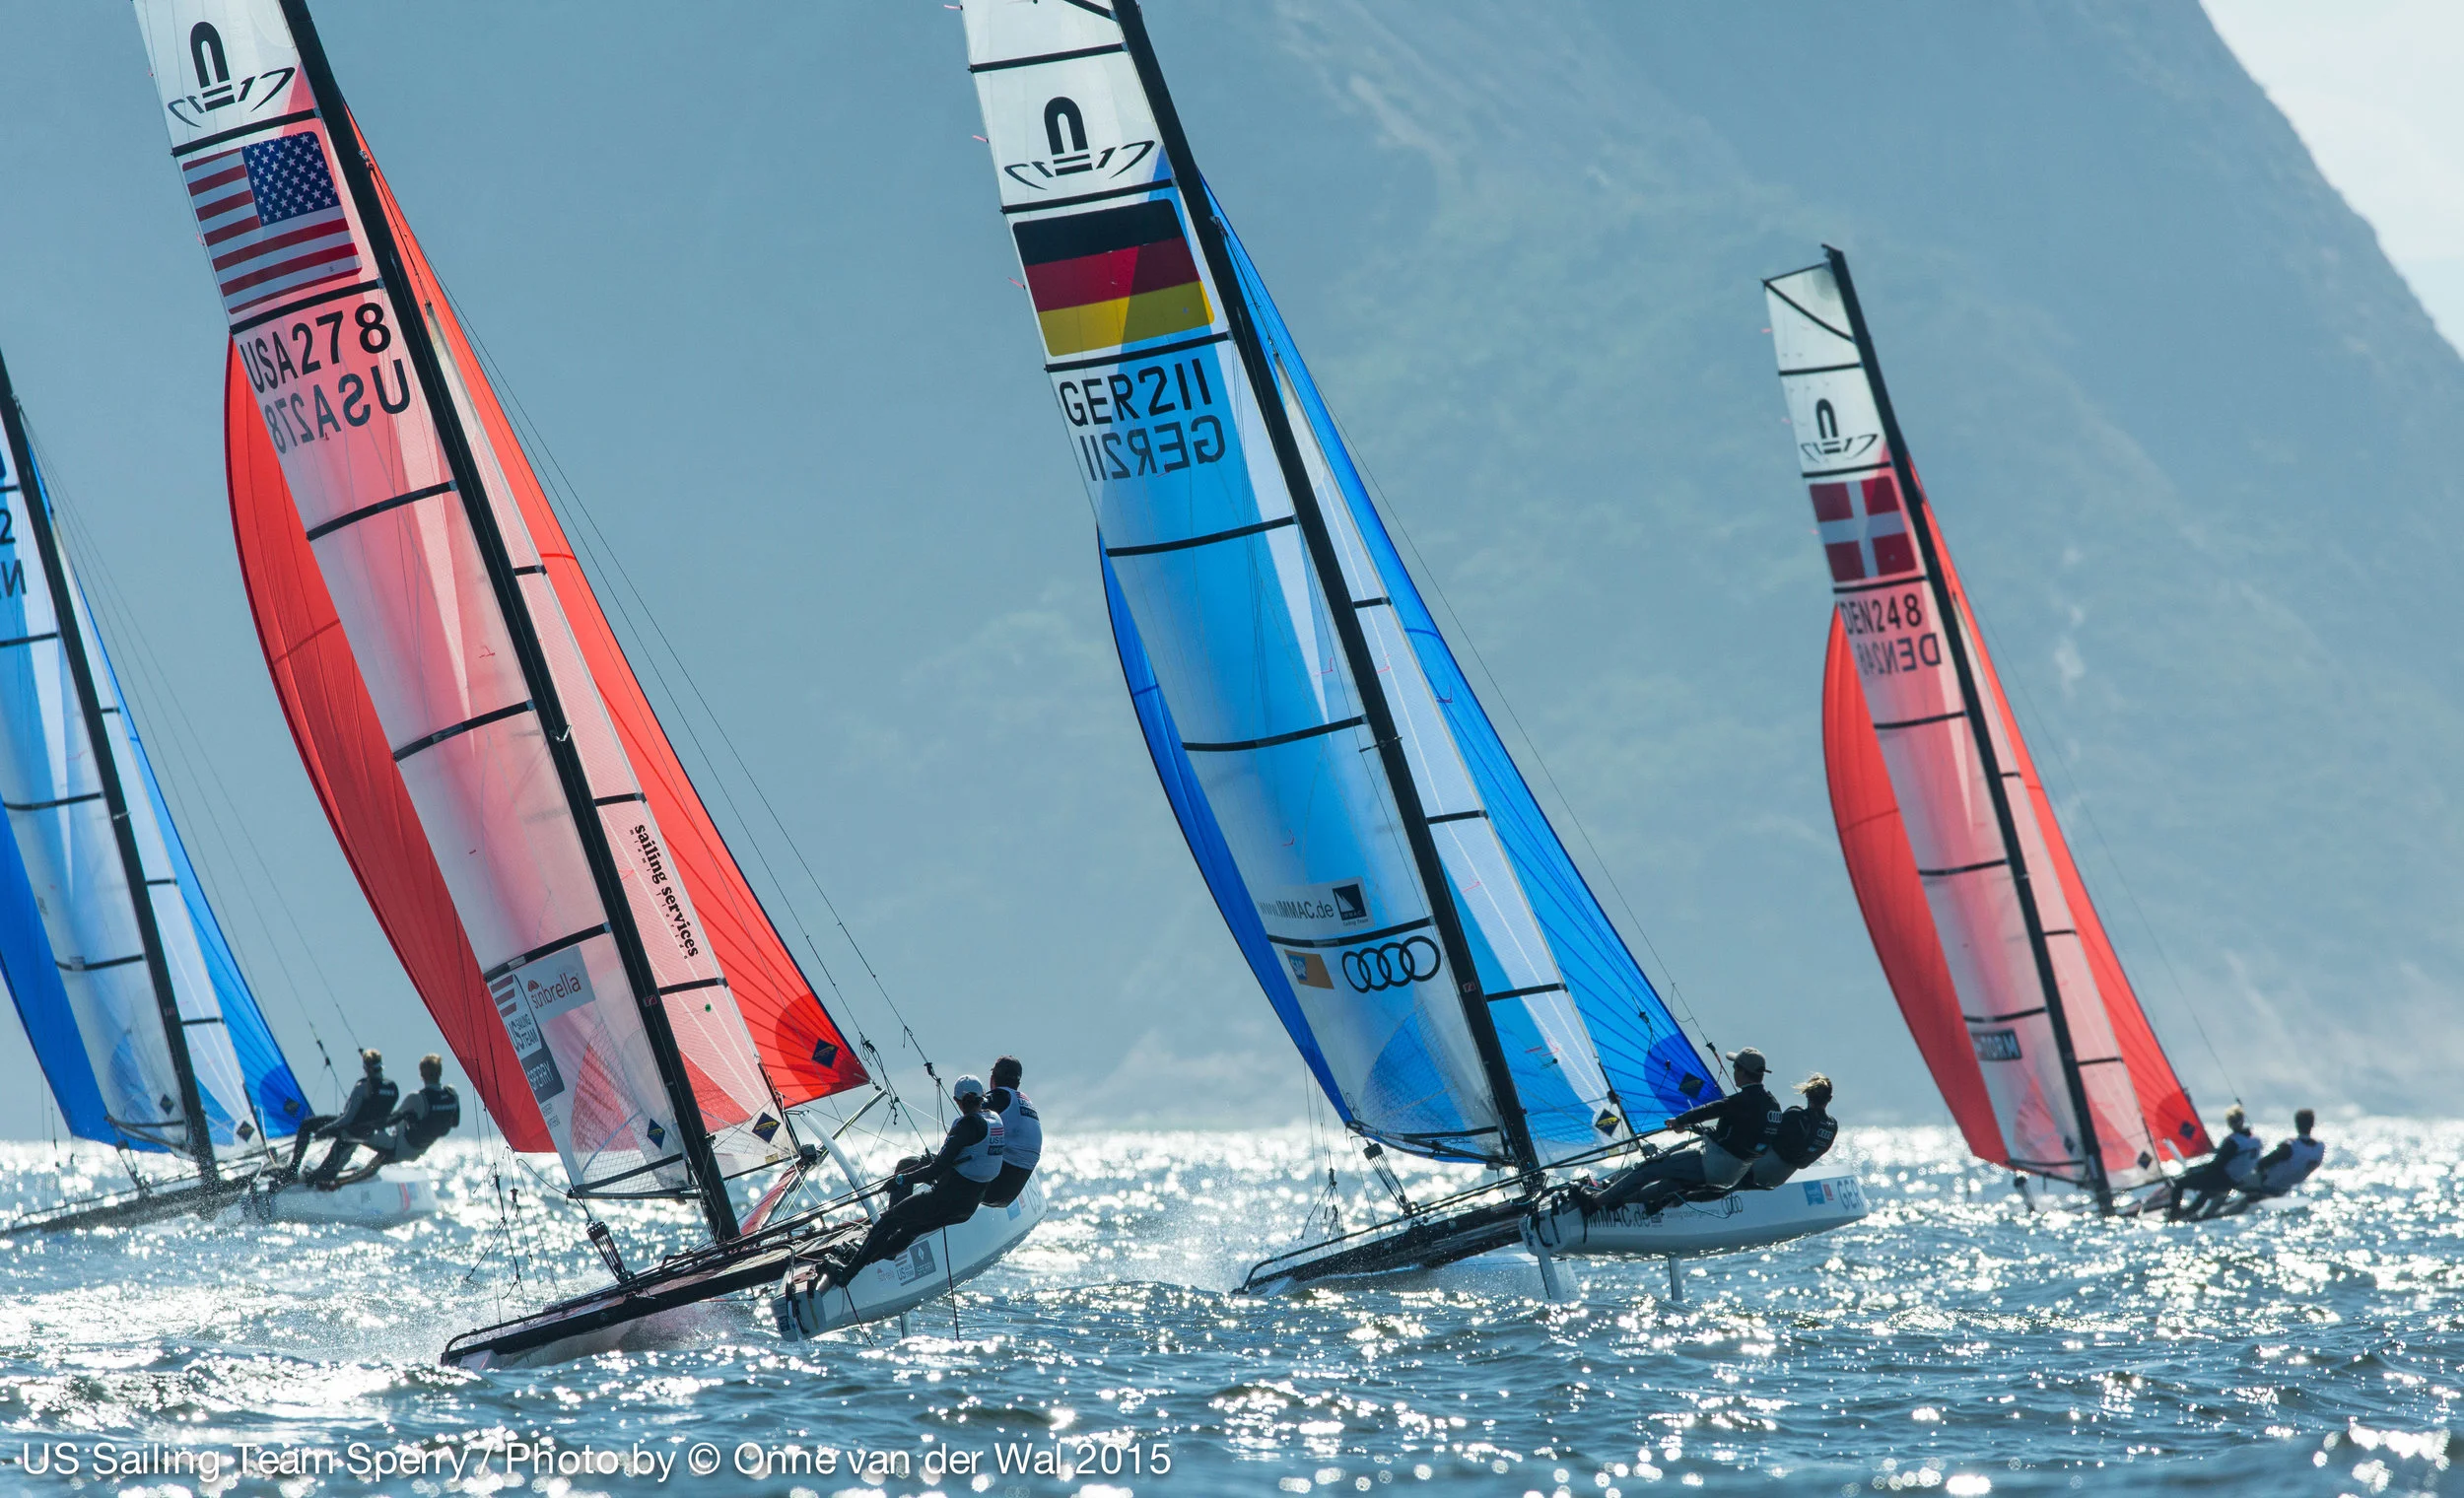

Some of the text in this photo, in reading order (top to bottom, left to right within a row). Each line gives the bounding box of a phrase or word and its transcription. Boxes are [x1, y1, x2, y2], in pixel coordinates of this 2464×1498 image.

[240, 302, 391, 394] USA278
[1059, 358, 1212, 428] GER211
[1839, 593, 1923, 635] DEN248
[634, 824, 700, 958] sailing services
[531, 973, 582, 1010] sunbrella
